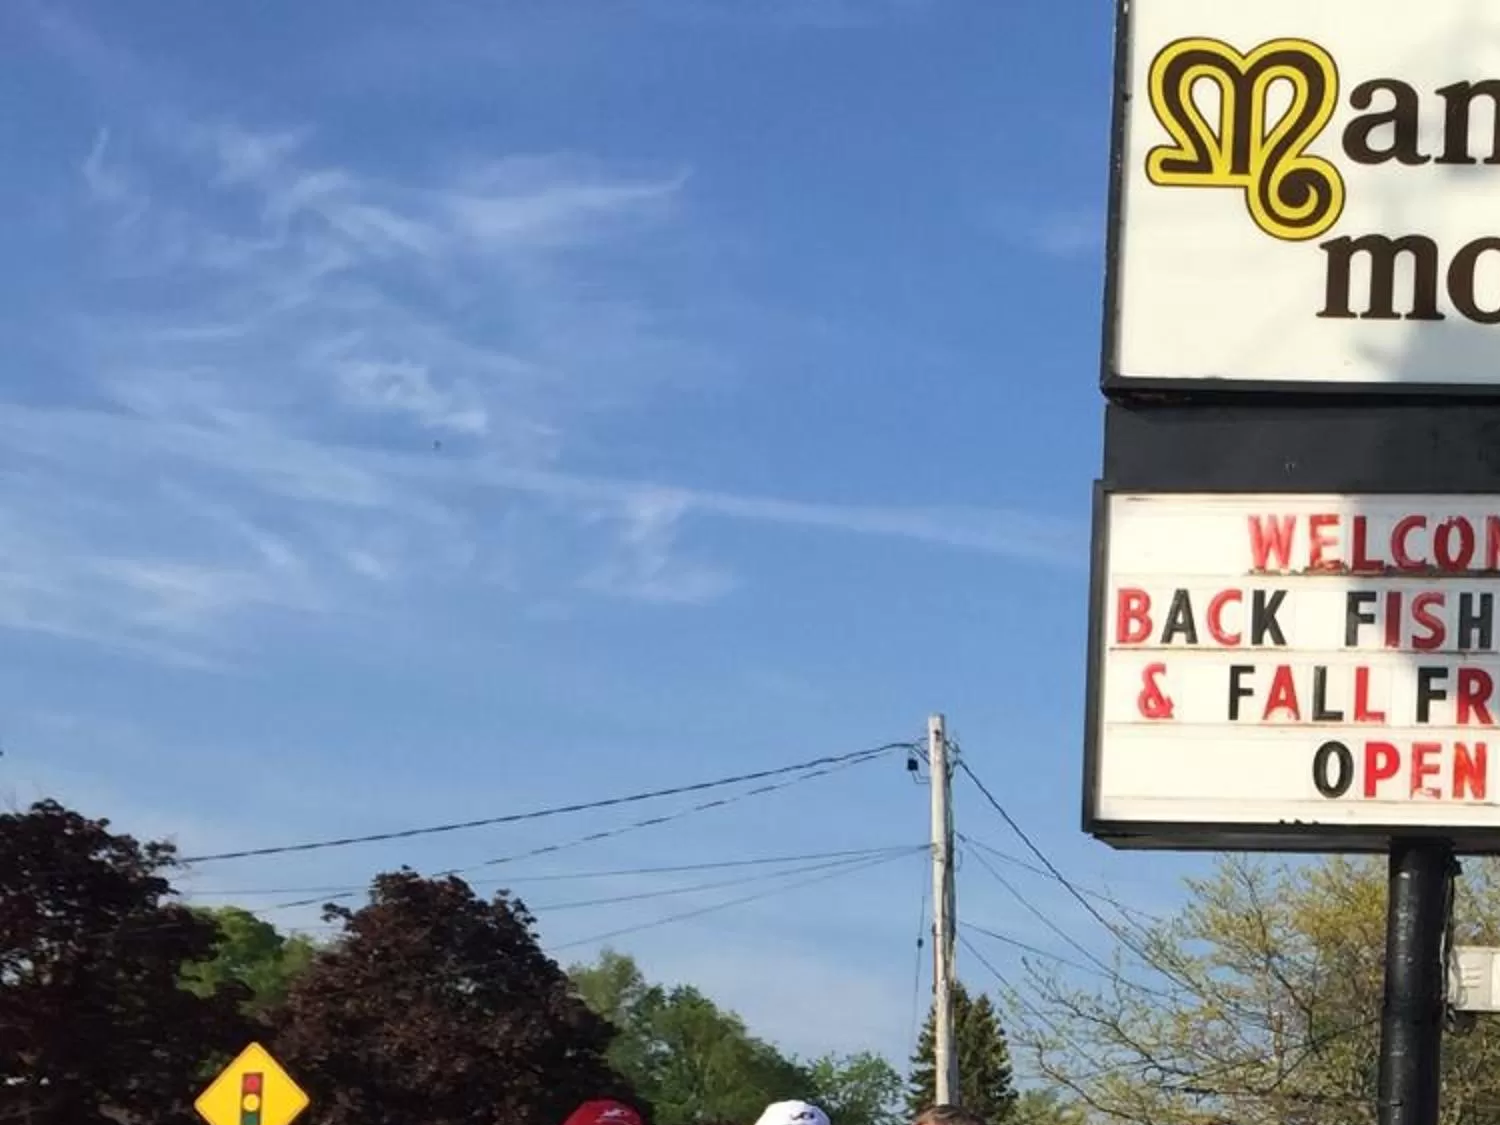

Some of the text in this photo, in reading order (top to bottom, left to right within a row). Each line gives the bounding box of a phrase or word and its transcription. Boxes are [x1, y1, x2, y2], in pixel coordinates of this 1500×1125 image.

[1115, 588, 1288, 646] BACK
[1137, 663, 1174, 720] &
[1227, 665, 1386, 724] FALL
[1312, 740, 1488, 800] OPEN
